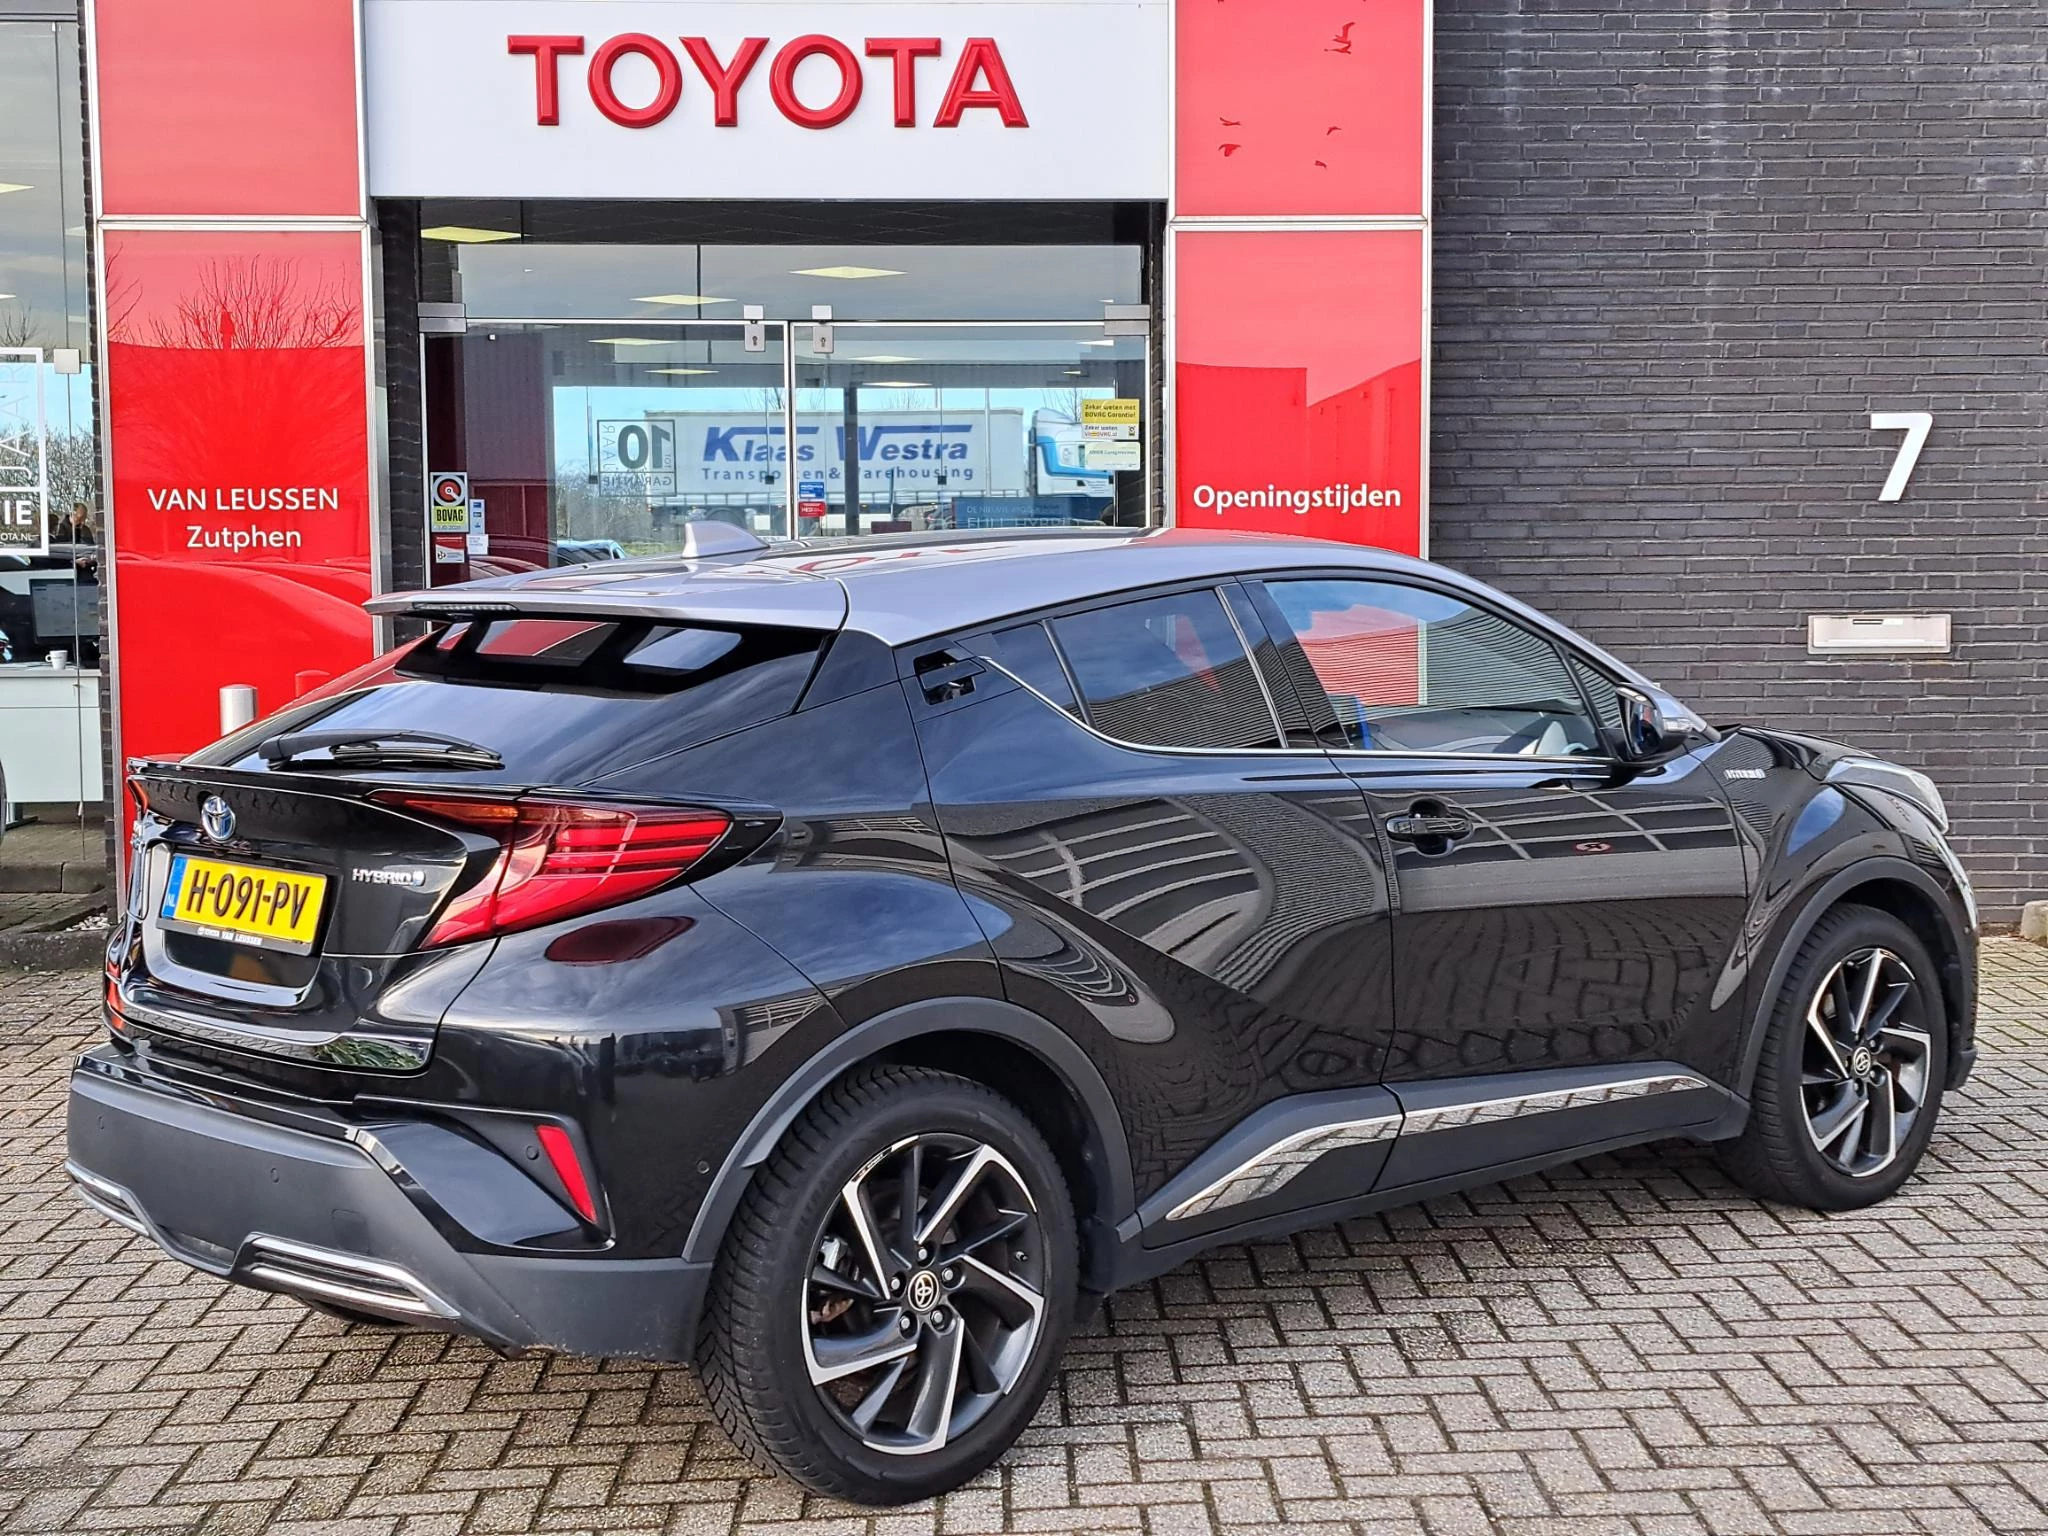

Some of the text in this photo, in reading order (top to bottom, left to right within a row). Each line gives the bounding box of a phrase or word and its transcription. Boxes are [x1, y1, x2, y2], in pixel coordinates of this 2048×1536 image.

[508, 32, 1030, 129] TOYOTA
[703, 425, 973, 462] Klaas Westra
[1870, 412, 1933, 501] 7
[702, 467, 825, 483] Transpoen
[857, 466, 973, 481] arehousing
[4, 499, 33, 525] IE
[147, 488, 339, 511] VAN LEUSSEN
[1193, 483, 1401, 515] Openingstijden
[436, 508, 464, 522] BOVAG
[0, 532, 36, 542] OTA.NL
[186, 524, 302, 553] Zutphen
[186, 869, 311, 930] H-091-PV
